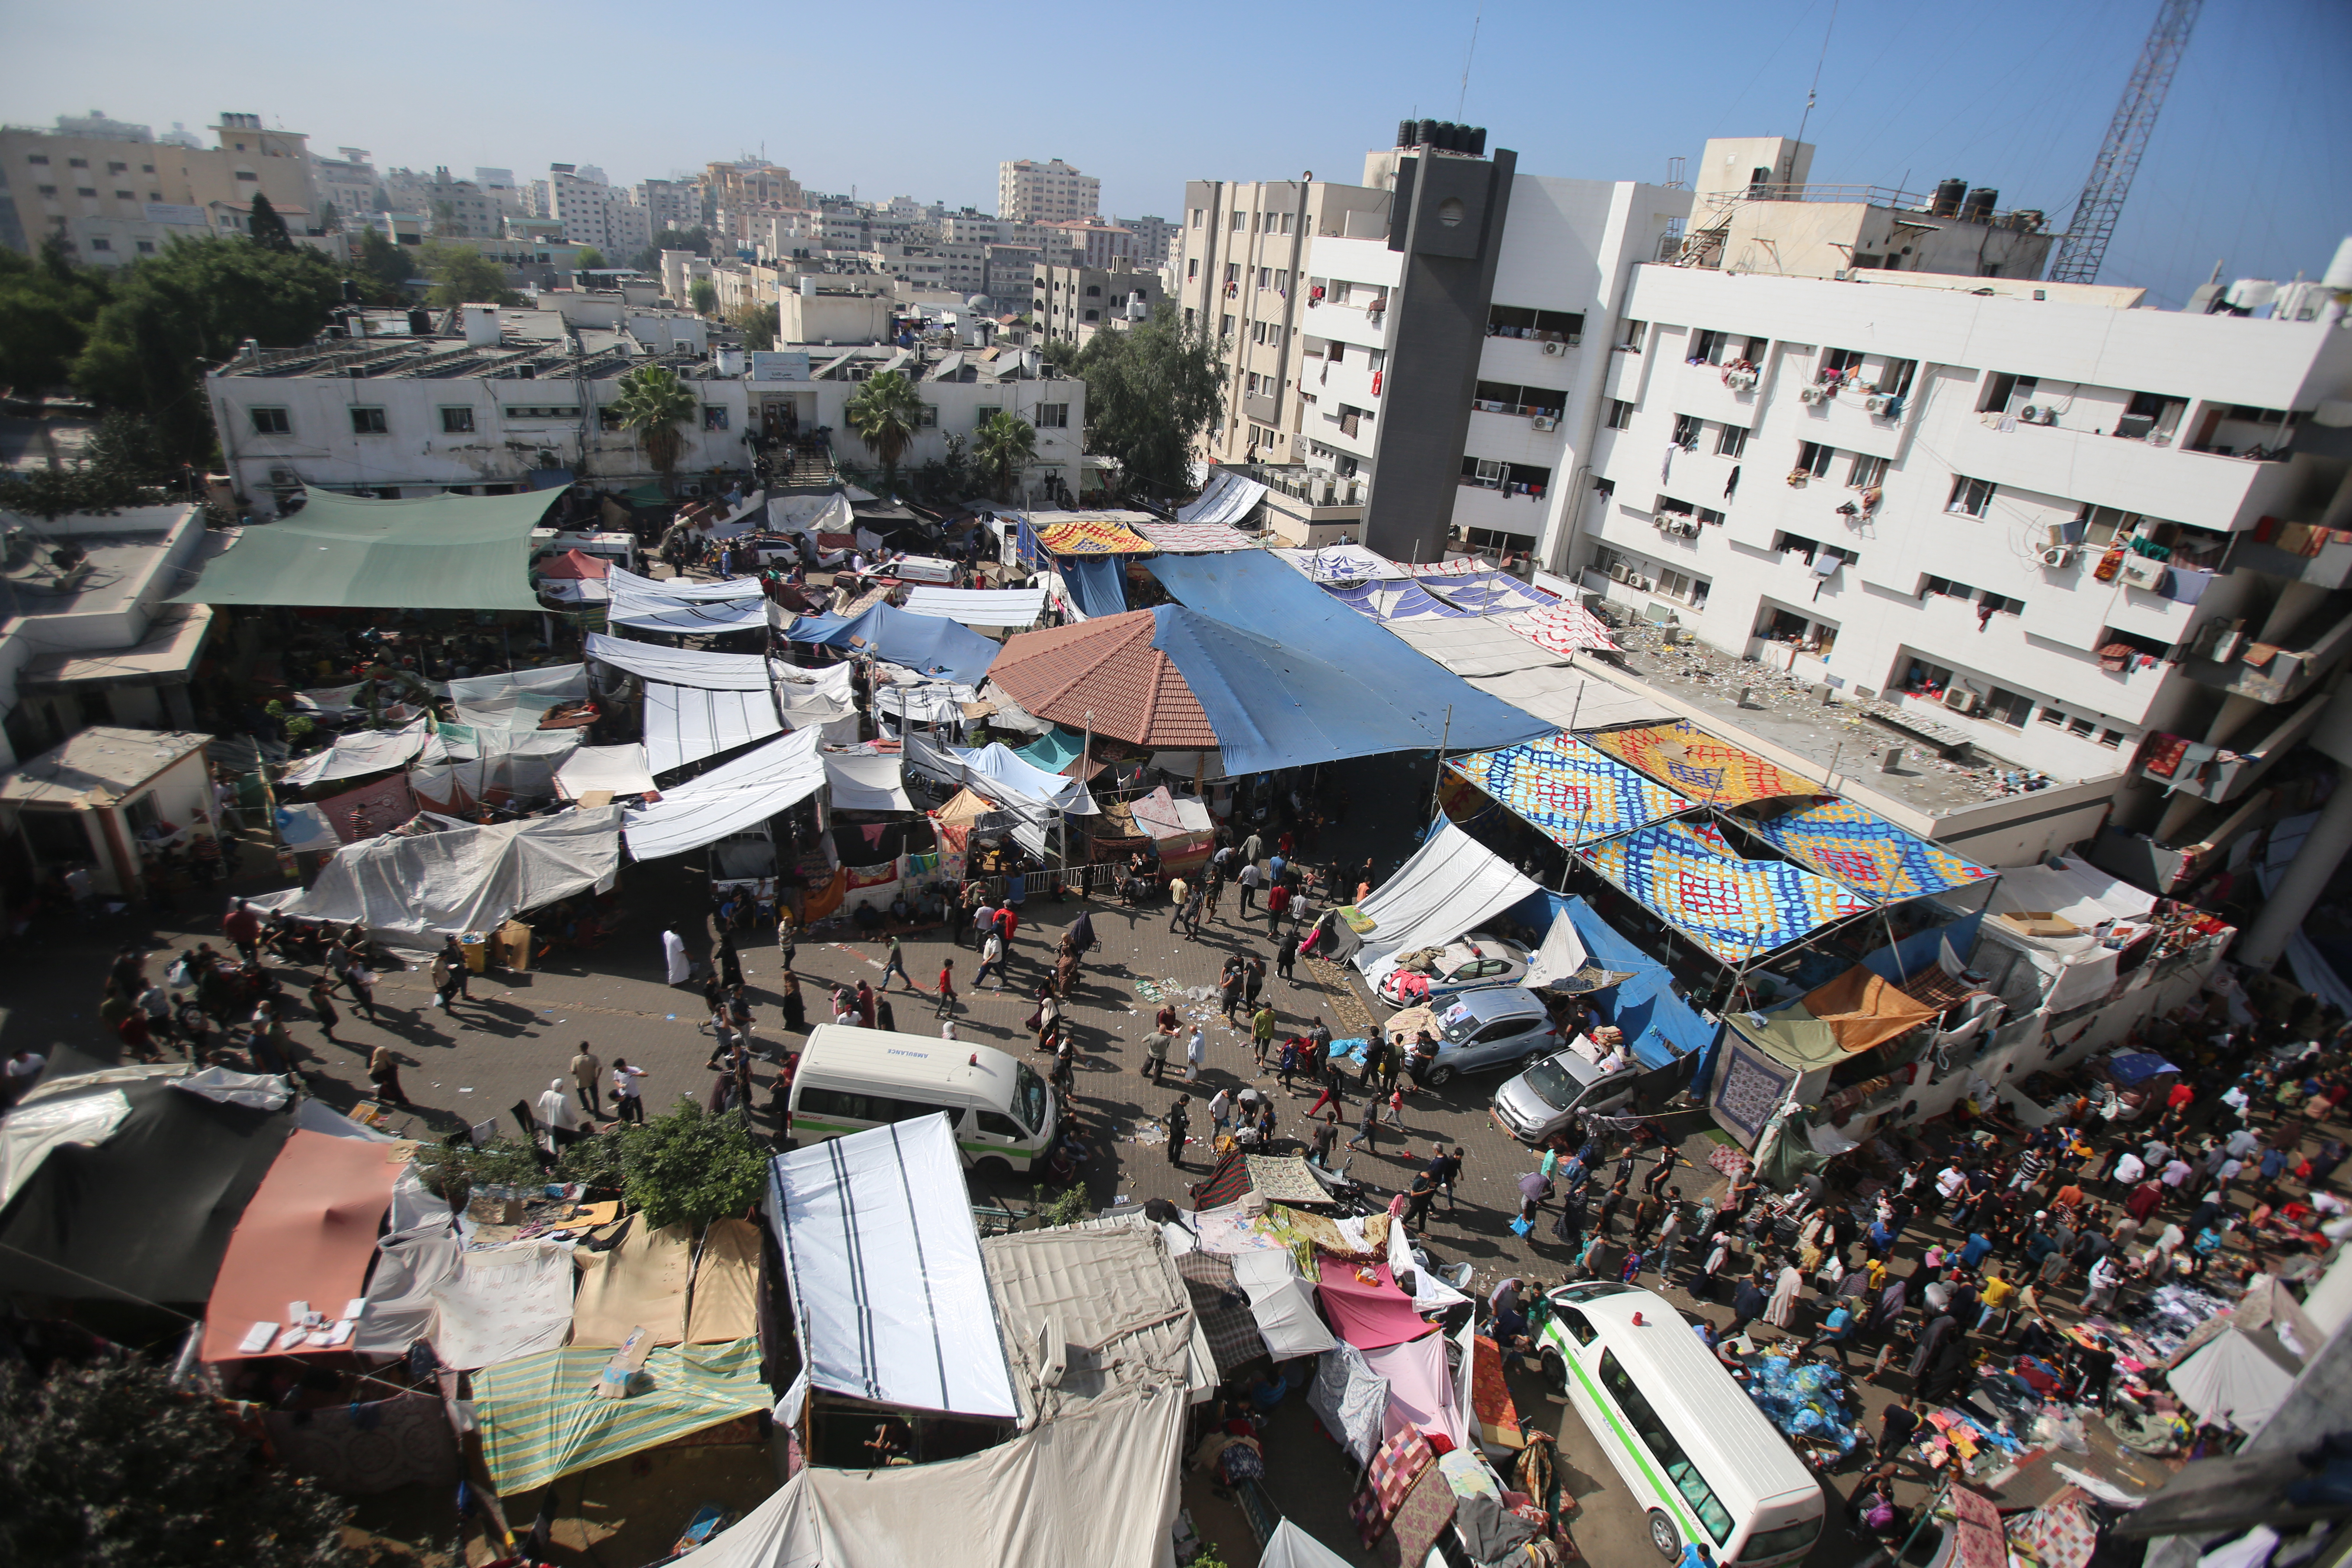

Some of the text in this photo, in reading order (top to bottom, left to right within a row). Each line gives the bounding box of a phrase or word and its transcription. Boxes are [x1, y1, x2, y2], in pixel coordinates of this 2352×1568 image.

[887, 1049, 929, 1059] AMBULANCE
[1616, 1408, 1626, 1423] صحية
[1678, 1497, 1702, 1532] وزارة الصحة
